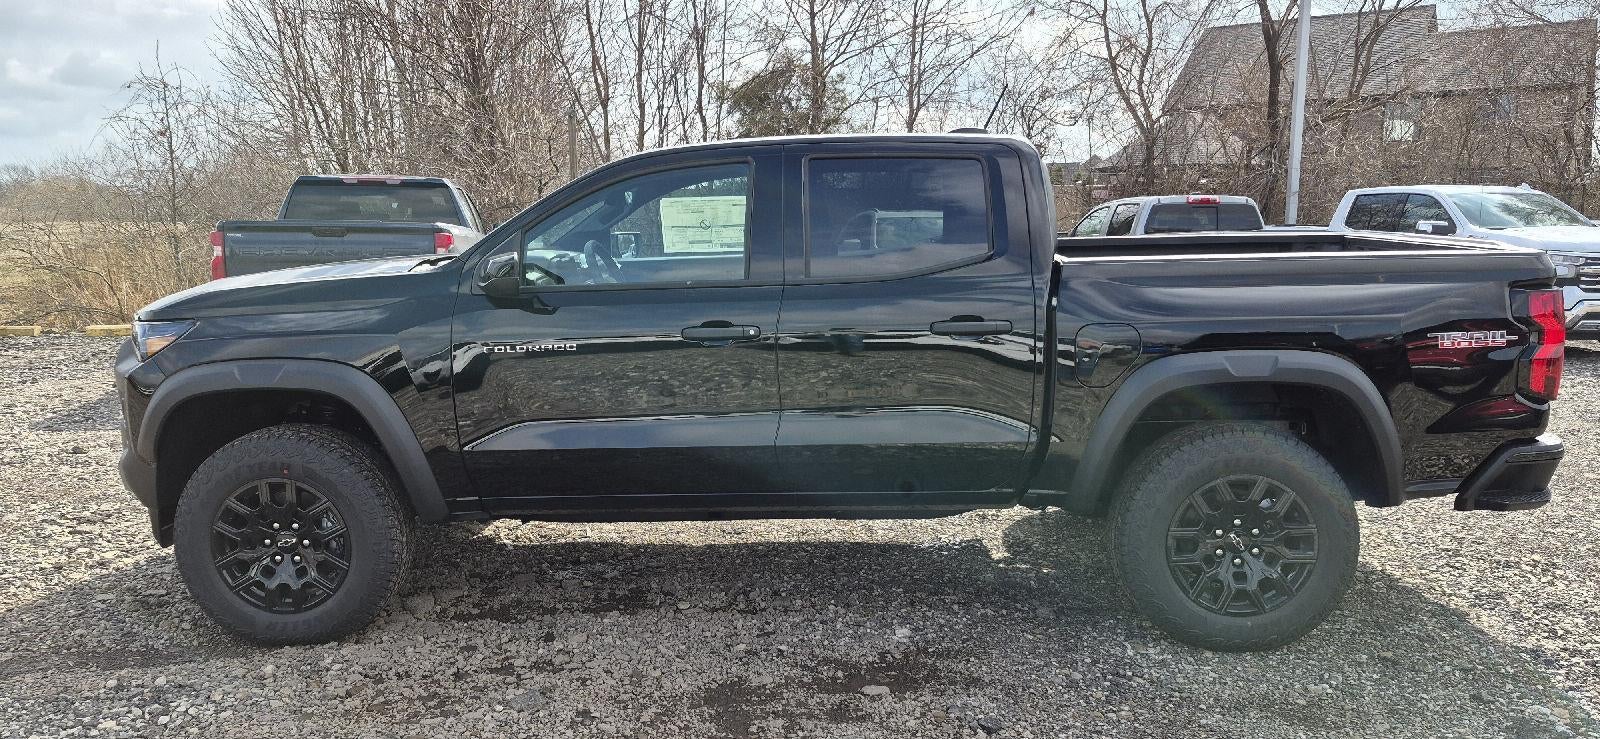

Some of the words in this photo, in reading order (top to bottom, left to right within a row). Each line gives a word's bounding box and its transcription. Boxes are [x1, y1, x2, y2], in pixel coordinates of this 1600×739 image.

[1427, 330, 1518, 341] TRAIL
[483, 343, 577, 353] COLORADO
[1439, 339, 1507, 348] BOSS
